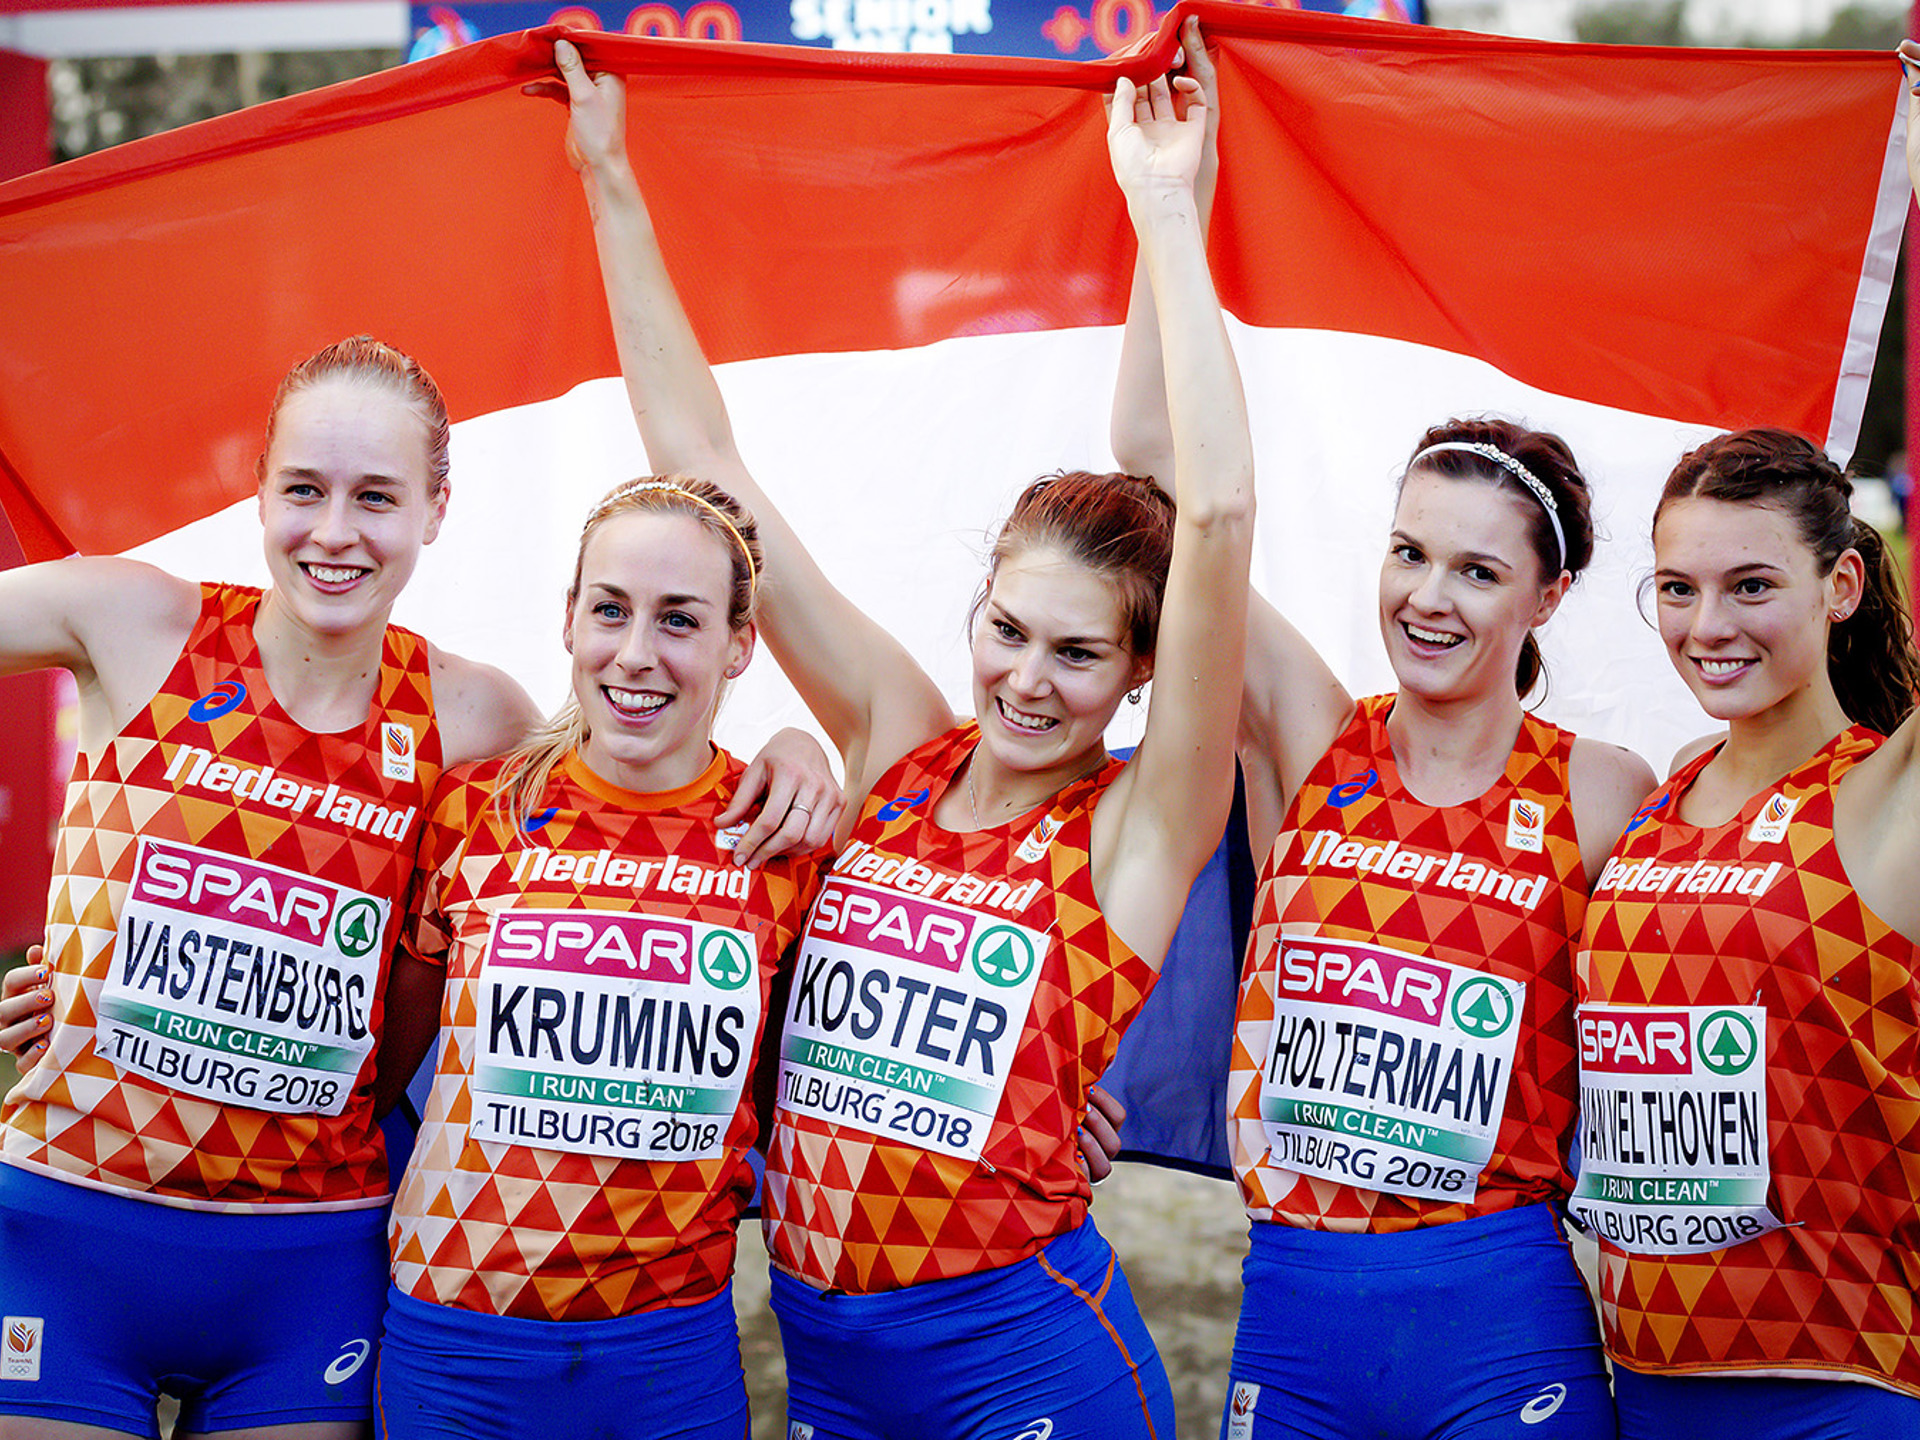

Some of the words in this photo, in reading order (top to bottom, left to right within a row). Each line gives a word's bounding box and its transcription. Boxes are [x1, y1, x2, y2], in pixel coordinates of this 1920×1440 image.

[141, 853, 330, 936] SPAR
[497, 921, 686, 974] SPAR
[814, 889, 966, 962] SPAR
[122, 916, 368, 1041] VASTENBURG
[1282, 949, 1442, 1017] SPAR
[167, 1016, 220, 1046] RUN
[489, 983, 744, 1078] KRUMINS
[793, 953, 1008, 1076] KOSTER
[1581, 1018, 1687, 1066] SPAR
[112, 1029, 258, 1098] TILBURG
[265, 1073, 338, 1108] 2018
[543, 1079, 596, 1100] RUN
[816, 1047, 855, 1072] RUN
[1268, 1015, 1502, 1127] HOLTERMAN
[487, 1103, 640, 1149] TILBURG
[650, 1121, 718, 1152] 2018
[784, 1070, 886, 1124] TILBURG
[889, 1101, 973, 1148] 2018
[1304, 1104, 1337, 1128] RUN
[1277, 1131, 1375, 1176] TILBURG
[1383, 1154, 1467, 1192] 2018
[1608, 1179, 1634, 1200] RUN
[1576, 1207, 1678, 1245] TILBURG
[1684, 1214, 1764, 1246] 2018
